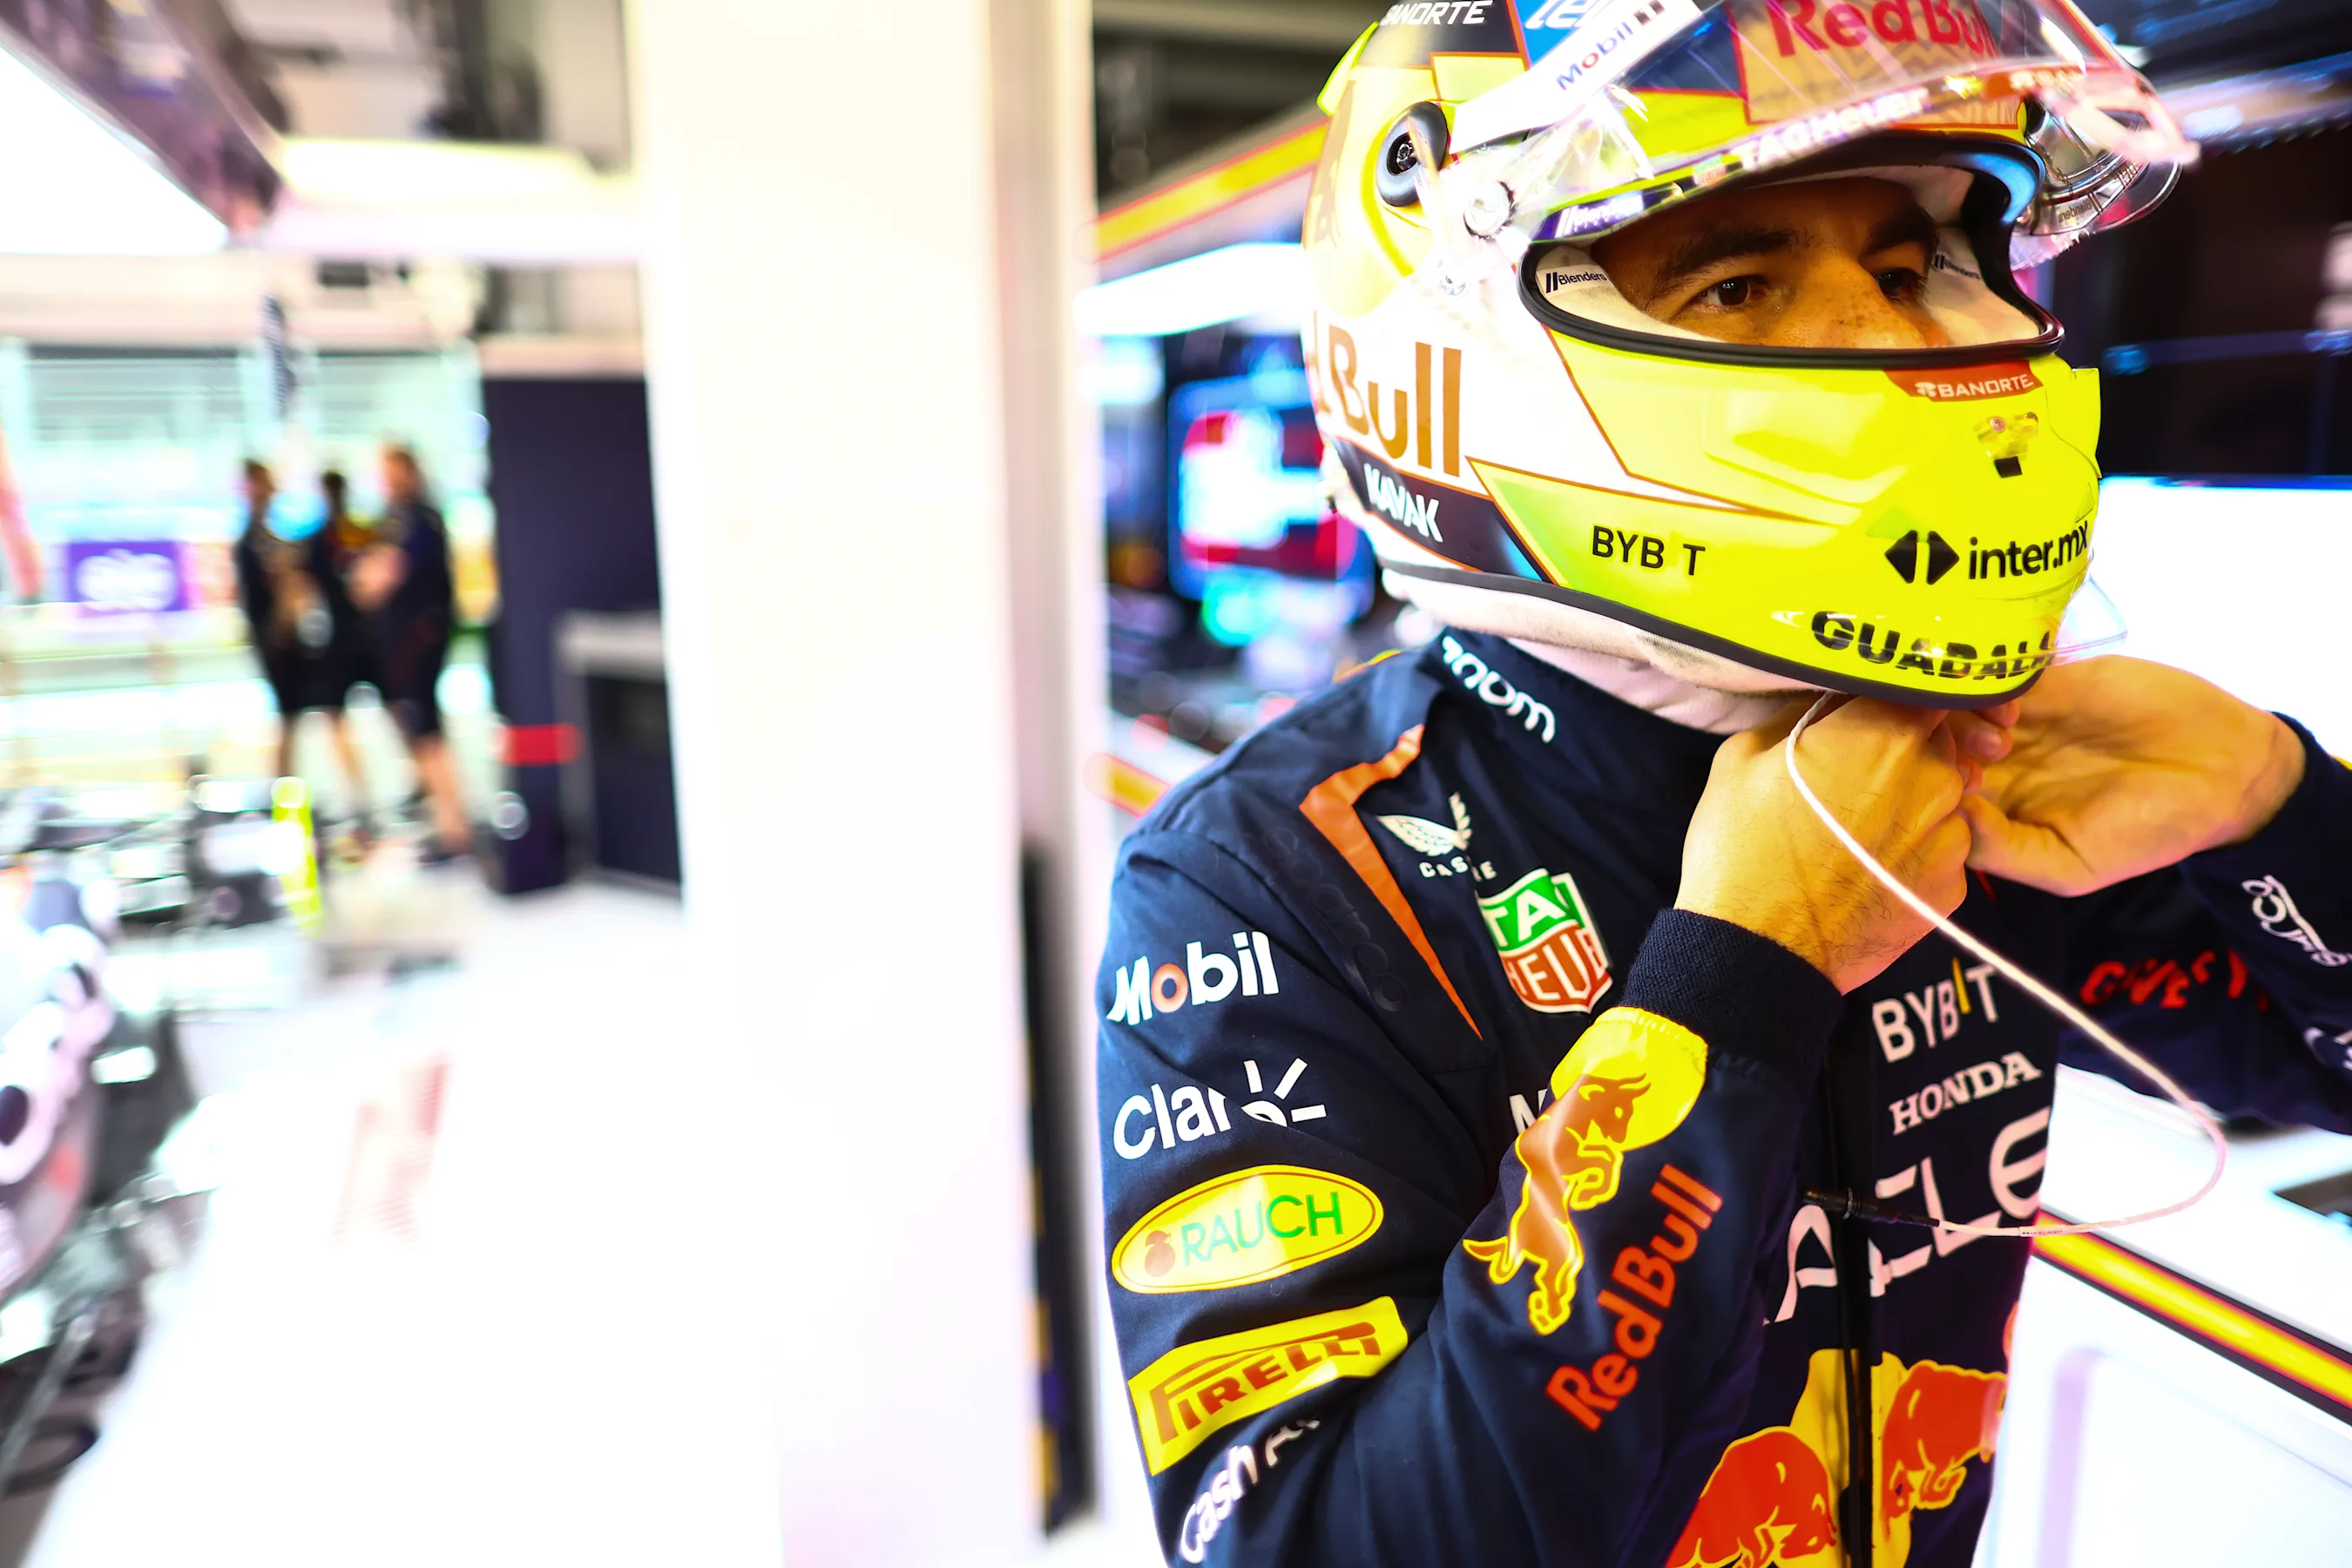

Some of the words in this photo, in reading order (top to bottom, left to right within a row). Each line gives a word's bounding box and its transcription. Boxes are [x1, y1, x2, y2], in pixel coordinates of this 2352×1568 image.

[1556, 21, 1634, 91] Mobil
[1767, 0, 1917, 57] Red
[1558, 271, 1608, 286] Blenders
[1328, 324, 1463, 477] Bull
[1937, 374, 2034, 398] BANORTE
[1363, 463, 1443, 543] KAVAK
[1969, 520, 2089, 580] inter.mx
[1481, 887, 1571, 948] TA
[1107, 931, 1280, 1026] Mobil
[1872, 956, 1999, 1064] BYBIT
[1889, 1051, 2044, 1136] HONDA
[1180, 1191, 1343, 1267] RAUCH
[1544, 1289, 1662, 1432] Red
[1612, 1163, 1723, 1308] Bull
[1149, 1321, 1381, 1445] PIRELLI
